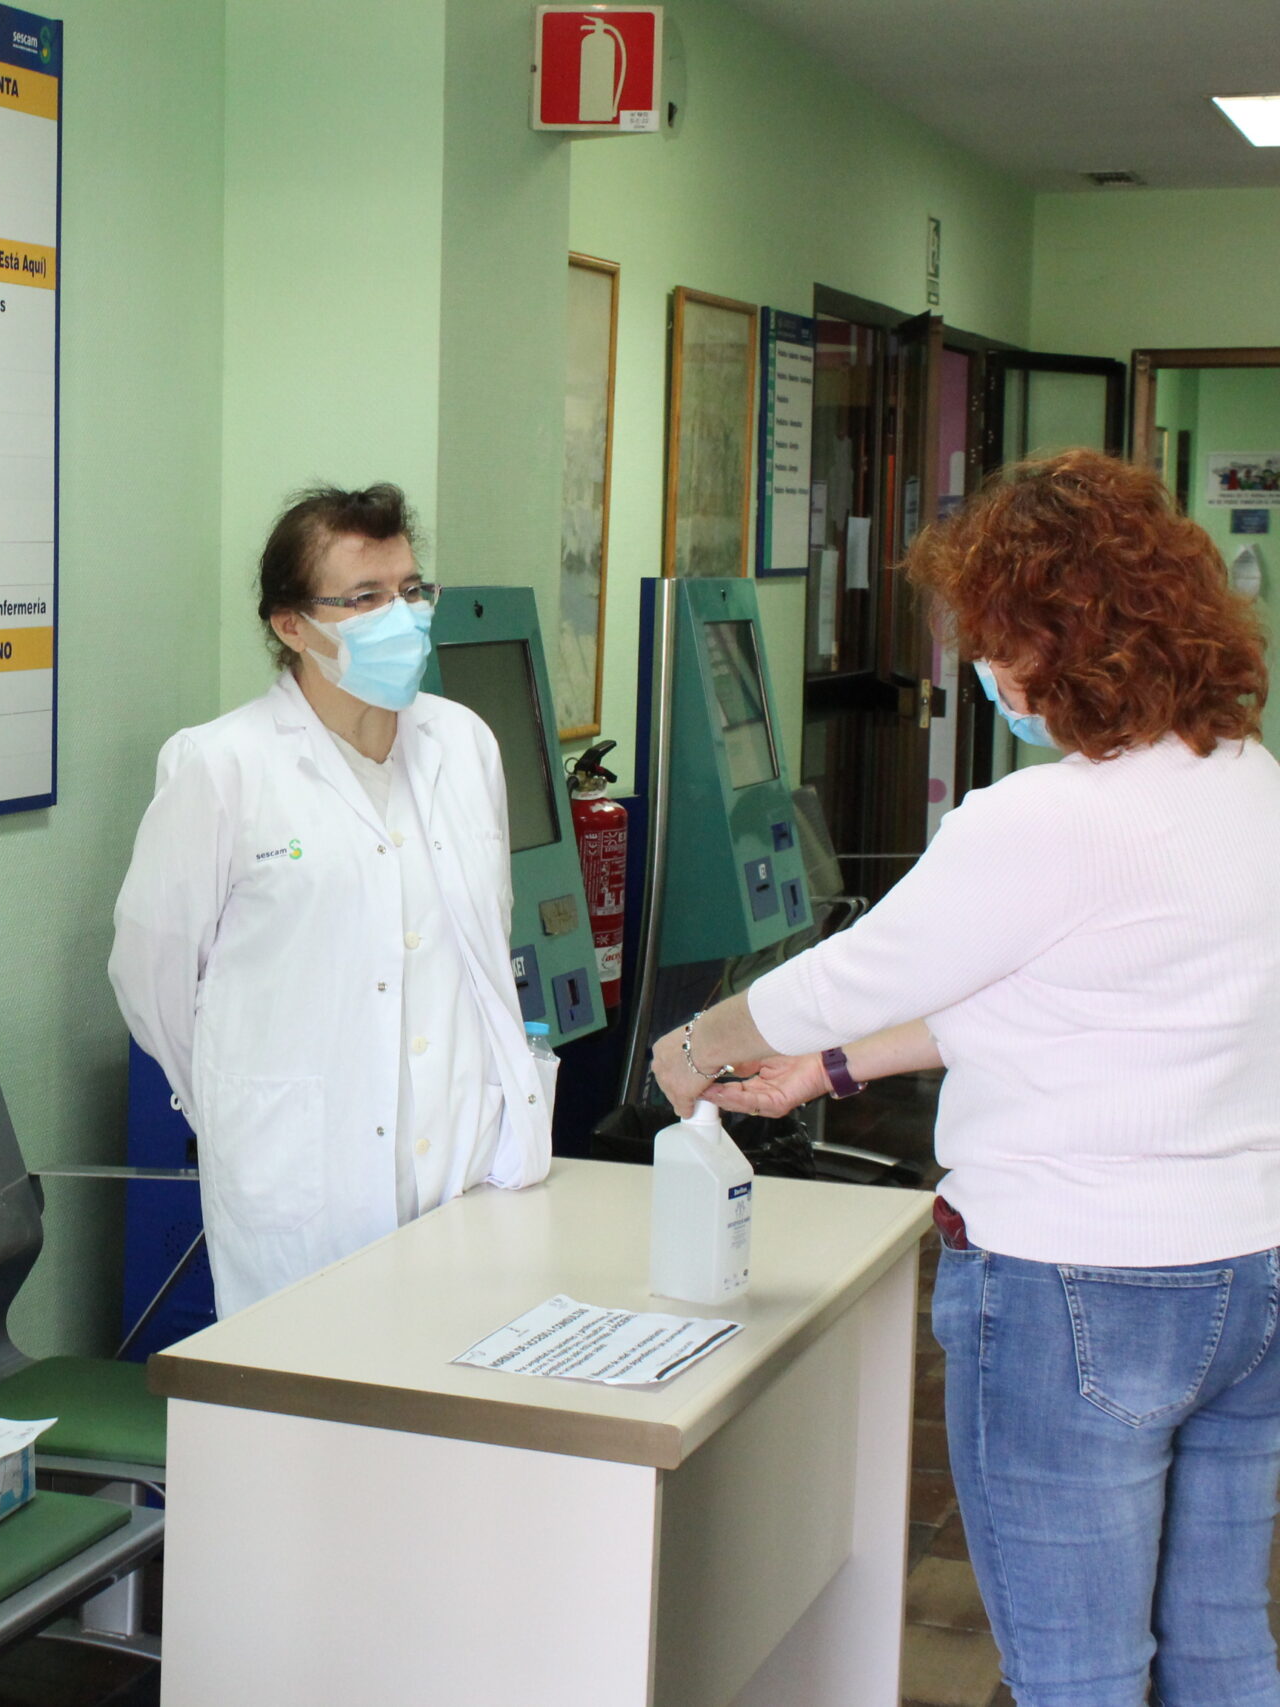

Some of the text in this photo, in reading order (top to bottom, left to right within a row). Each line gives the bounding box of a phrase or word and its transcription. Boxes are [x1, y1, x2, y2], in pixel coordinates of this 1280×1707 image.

[13, 31, 38, 48] sescam
[22, 254, 47, 279] Aquí)
[256, 848, 287, 860] sescam
